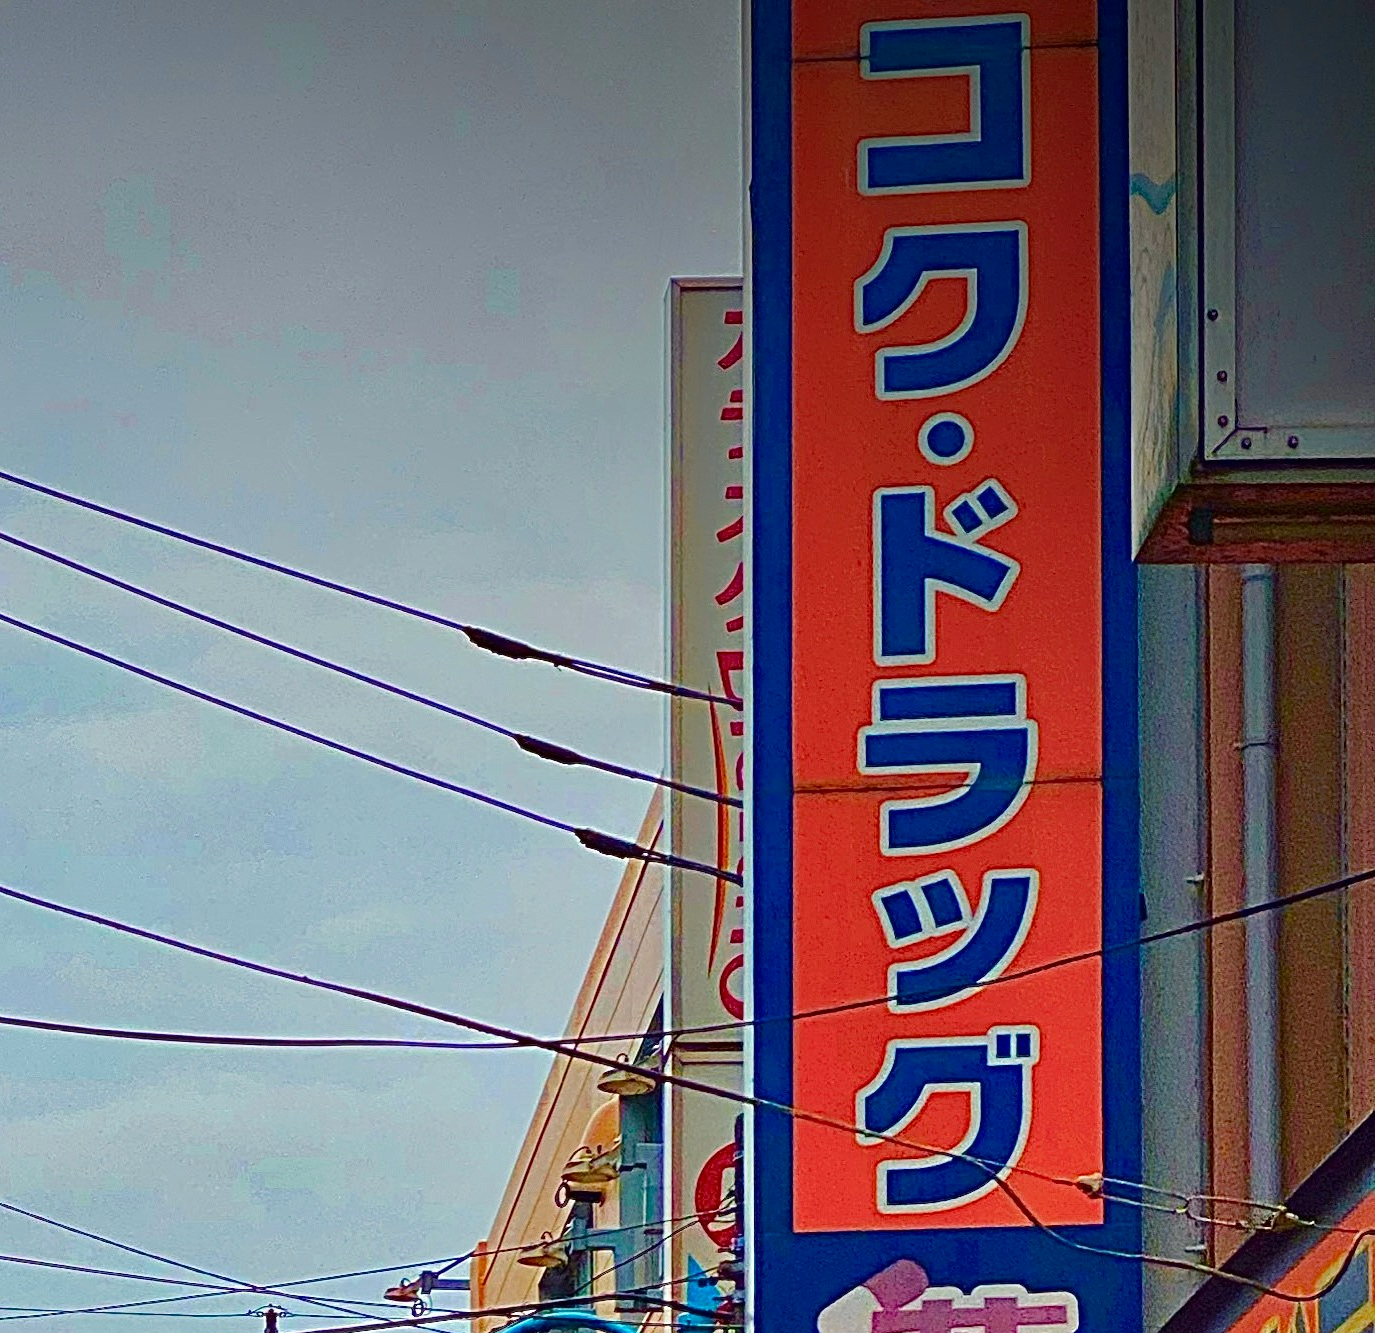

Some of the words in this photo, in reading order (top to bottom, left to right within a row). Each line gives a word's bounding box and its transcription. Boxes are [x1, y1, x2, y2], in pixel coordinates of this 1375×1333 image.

[854, 14, 1041, 1216] コク・ドラッグ
